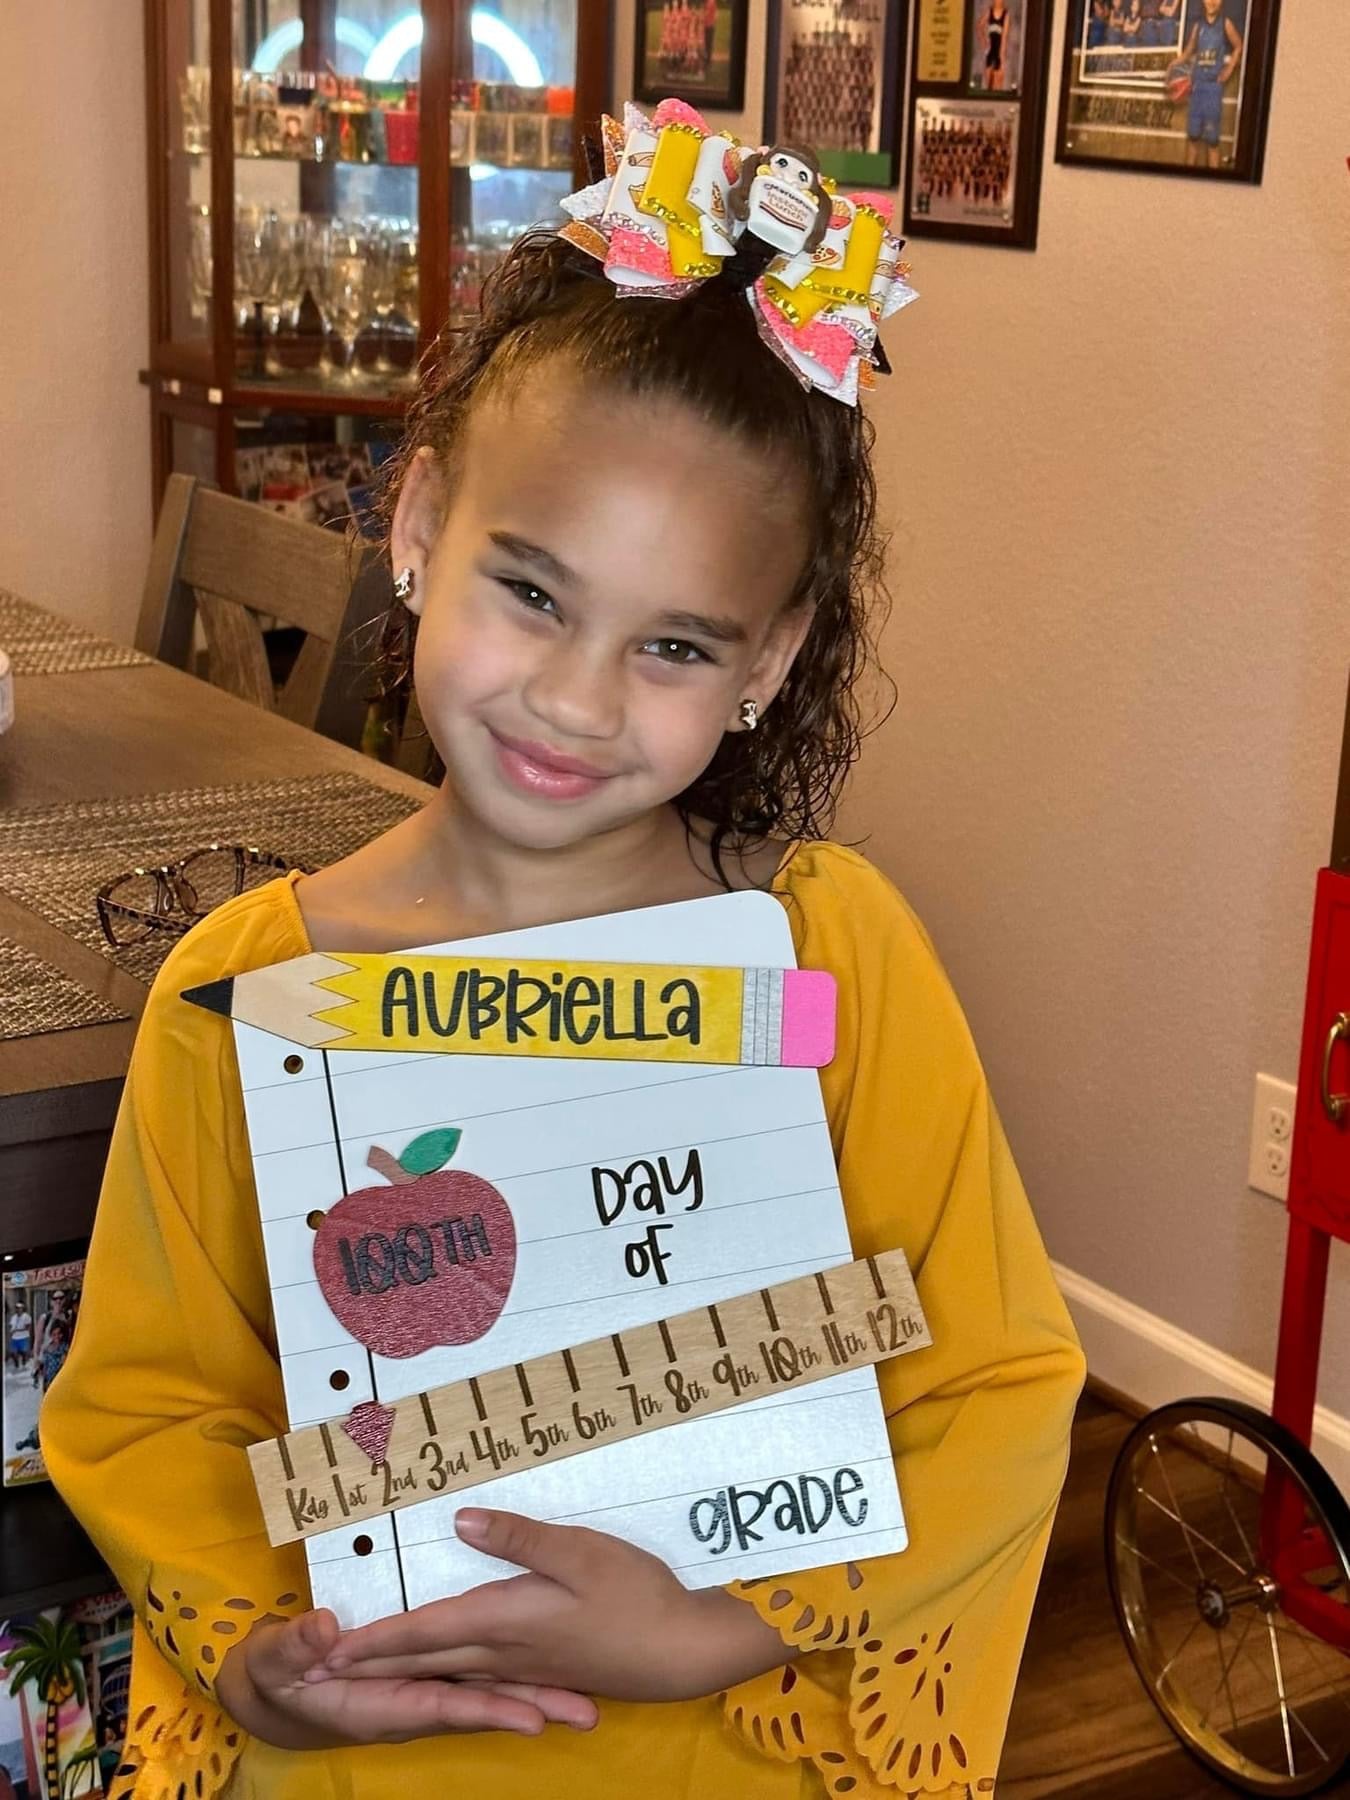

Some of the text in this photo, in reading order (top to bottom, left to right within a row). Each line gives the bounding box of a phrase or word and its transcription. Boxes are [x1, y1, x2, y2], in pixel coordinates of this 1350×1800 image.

[337, 1213, 492, 1295] 100TH
[285, 1303, 924, 1531] Kdg 1st 2nd 3rd 4th 5th 6th 7th 8th 9th 10th 11th 12th
